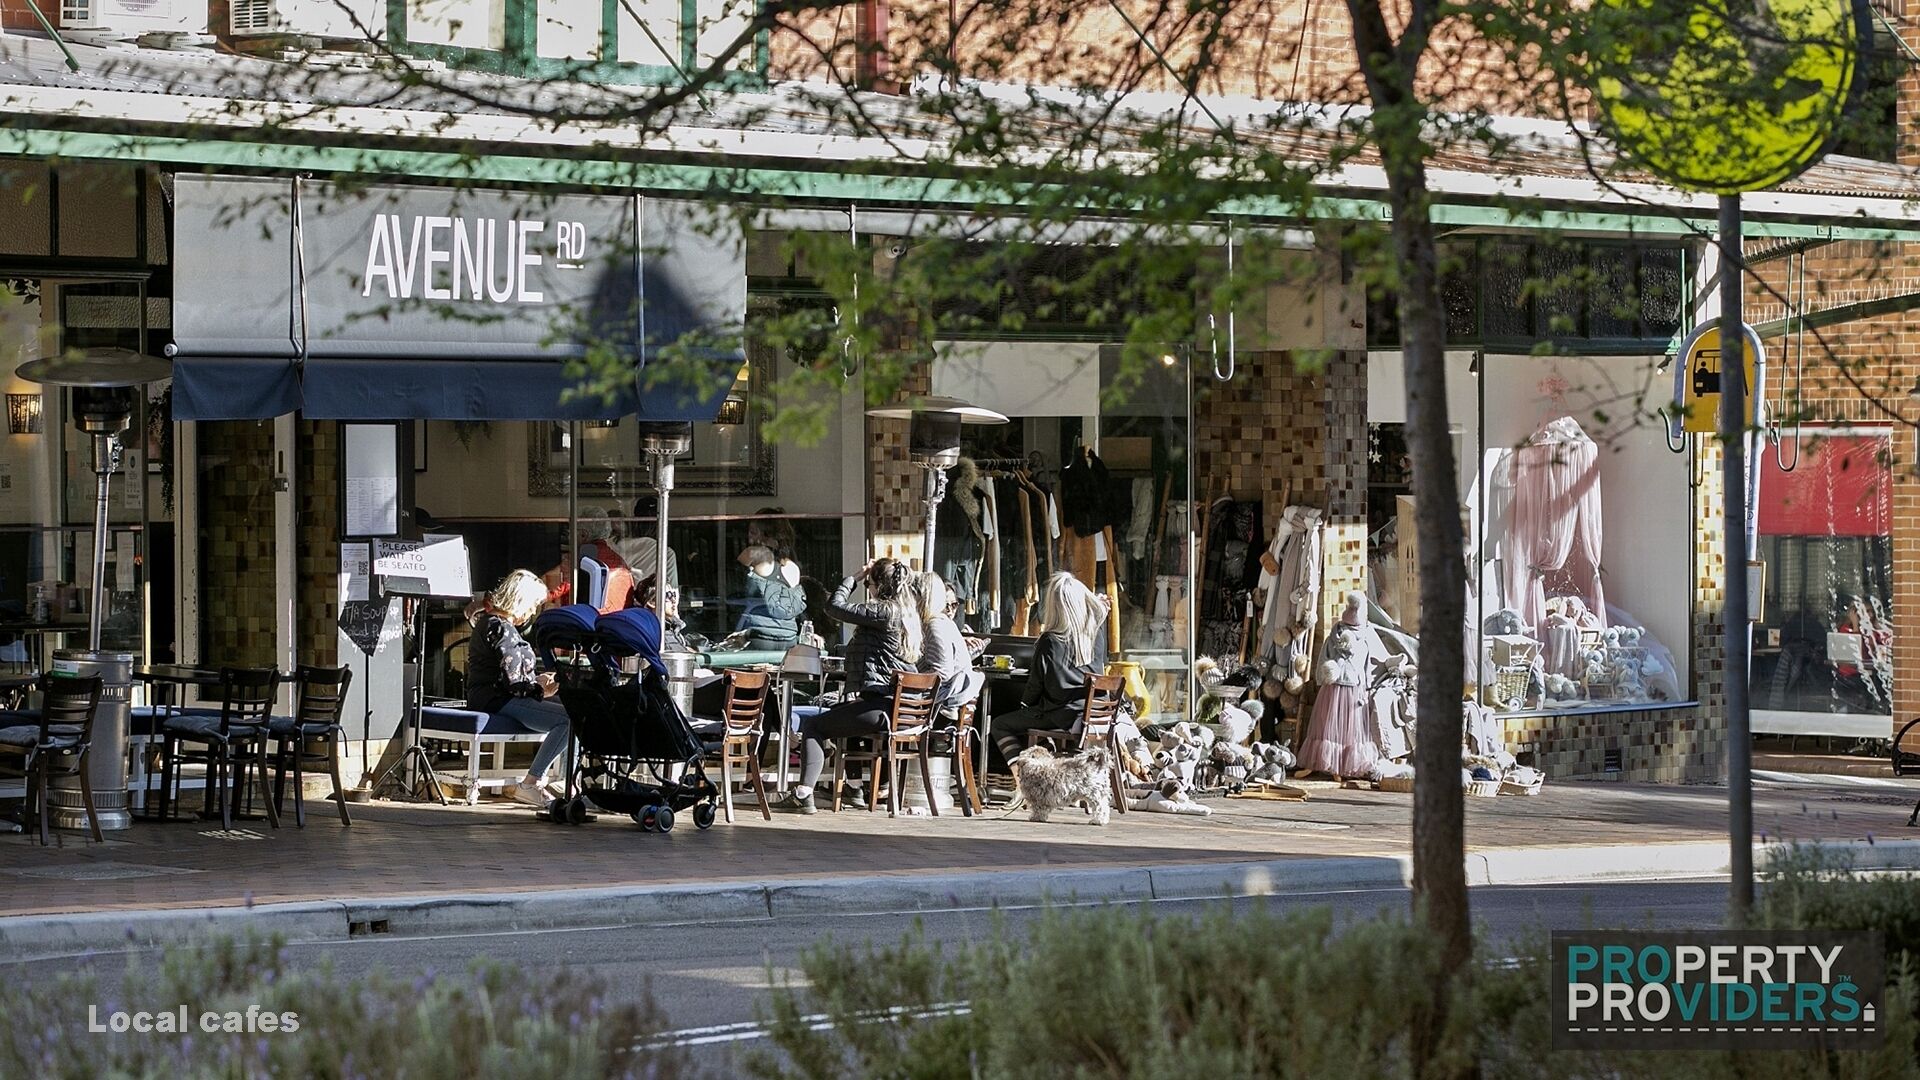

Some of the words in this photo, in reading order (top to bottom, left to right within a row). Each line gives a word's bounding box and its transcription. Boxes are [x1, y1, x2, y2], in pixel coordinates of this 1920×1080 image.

[362, 214, 544, 303] AVENUE
[557, 221, 586, 260] RD
[379, 551, 405, 560] WAIT
[410, 554, 423, 562] TO
[378, 560, 388, 568] BE
[391, 562, 426, 571] SEATED
